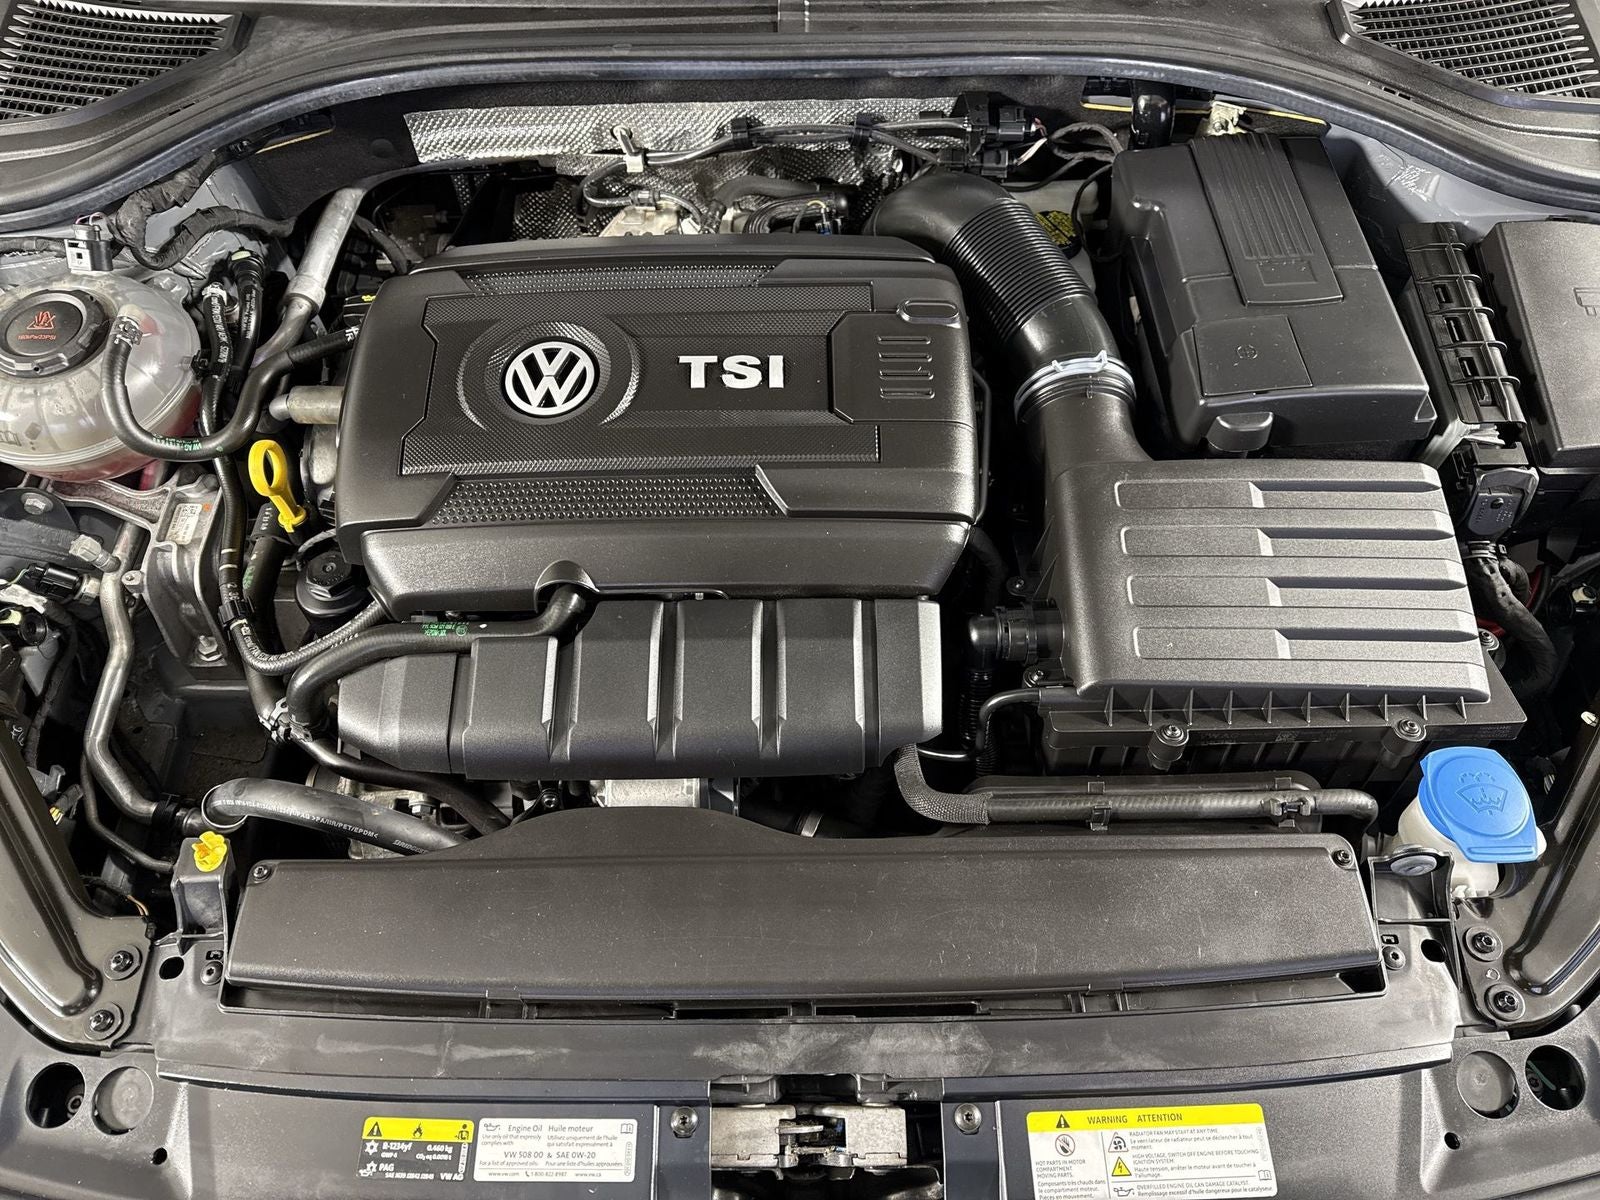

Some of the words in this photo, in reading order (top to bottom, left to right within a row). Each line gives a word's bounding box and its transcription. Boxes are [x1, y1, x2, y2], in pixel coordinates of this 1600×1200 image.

[677, 354, 785, 389] TSI
[504, 341, 596, 417] VW
[1087, 1115, 1128, 1125] WARNING
[1137, 1113, 1183, 1123] ATTENTION
[508, 1125, 532, 1134] Engine
[532, 1124, 543, 1132] Oil
[548, 1124, 567, 1132] Huile
[382, 1141, 413, 1153] R-1234yf
[444, 1144, 454, 1154] kg
[518, 1151, 532, 1159] 508
[533, 1151, 544, 1159] 00
[556, 1151, 571, 1159] SAE
[571, 1151, 596, 1159] 0W-20
[378, 1163, 395, 1172] PAG
[440, 1172, 452, 1180] VW
[452, 1173, 464, 1181] AG
